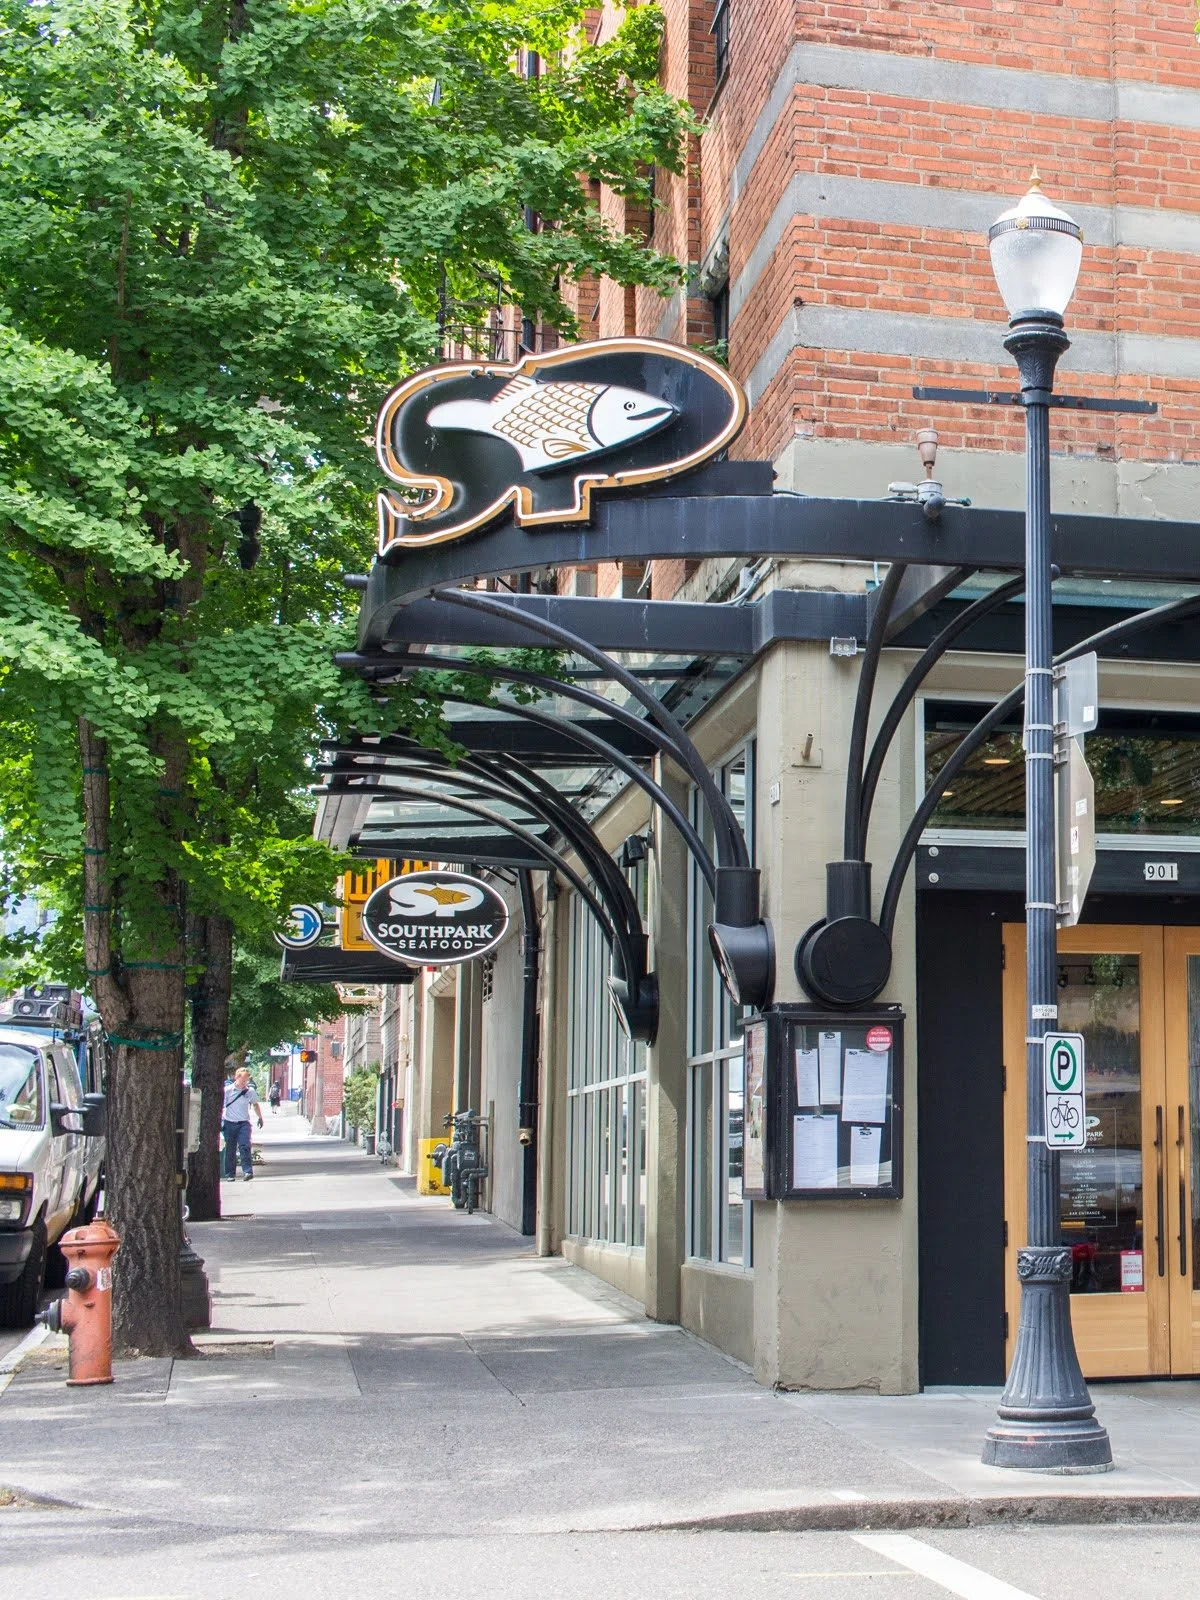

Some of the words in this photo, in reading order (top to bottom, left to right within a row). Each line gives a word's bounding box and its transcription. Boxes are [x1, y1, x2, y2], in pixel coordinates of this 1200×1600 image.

[1147, 865, 1174, 879] 901
[377, 923, 493, 939] SOUTHPARK
[398, 939, 473, 950] SEAFOOD
[1057, 1050, 1070, 1081] P
